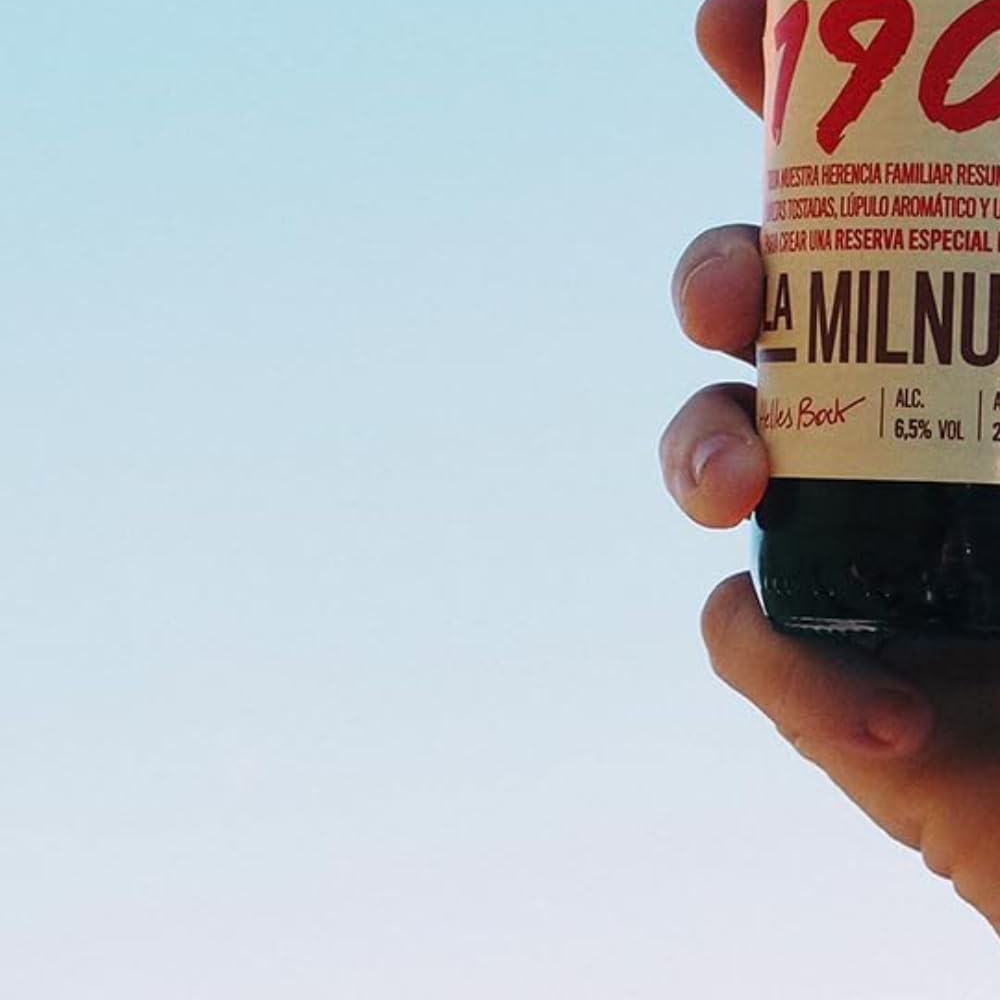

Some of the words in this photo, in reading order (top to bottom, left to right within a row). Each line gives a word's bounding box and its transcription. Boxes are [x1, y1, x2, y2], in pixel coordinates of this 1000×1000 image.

[822, 163, 882, 186] HERENCIA
[885, 163, 951, 185] FAMILIAR
[841, 192, 888, 218] LÚPULO
[892, 192, 976, 218] AROMÁTICO
[980, 198, 993, 219] Y
[809, 229, 832, 251] UNA
[835, 228, 903, 250] RESERVA
[909, 228, 993, 253] ESPECIAL
[761, 273, 792, 331] LA
[895, 387, 925, 409] ALC.
[894, 418, 932, 441] 6,5%
[938, 419, 965, 440] VOL
